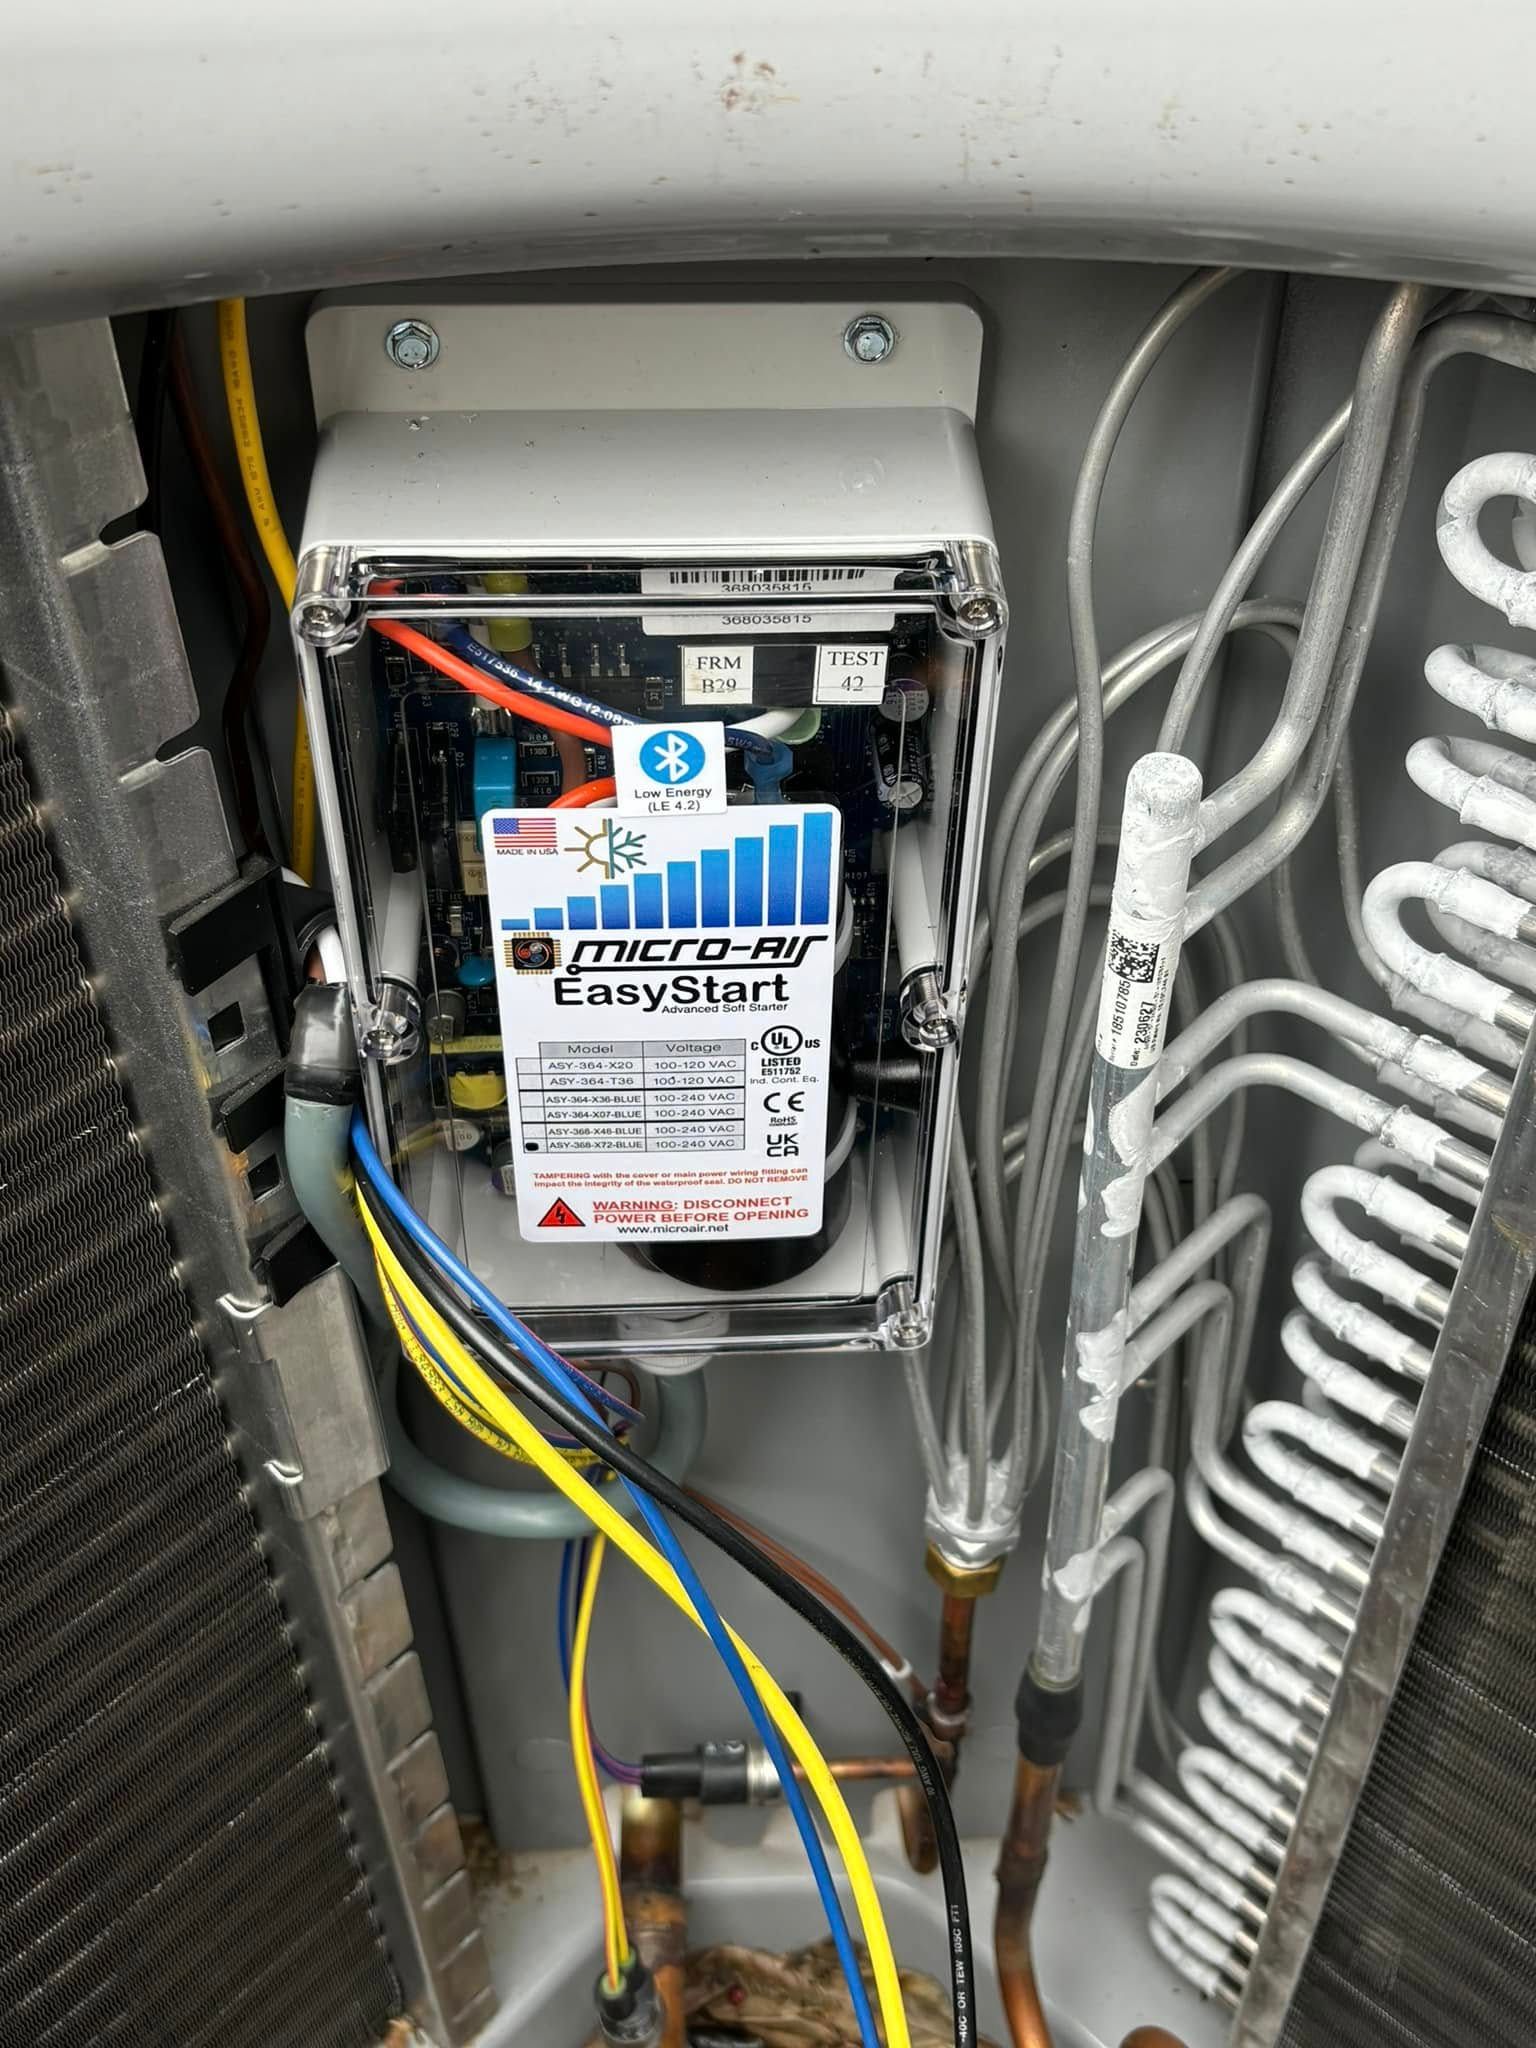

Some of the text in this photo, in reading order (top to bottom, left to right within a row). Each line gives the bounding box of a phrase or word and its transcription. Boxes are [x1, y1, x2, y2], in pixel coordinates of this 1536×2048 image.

[697, 656, 742, 670] FRM
[827, 651, 884, 666] TEST
[702, 678, 737, 694] B29
[841, 675, 864, 691] 42
[545, 687, 582, 708] AWG
[634, 786, 713, 800] Low Energy
[648, 800, 701, 814] (LE 4.2)
[496, 848, 559, 857] MADE IN USA
[554, 973, 790, 1013] EasyStart
[661, 1001, 788, 1015] Advanced Soft Starter
[1111, 980, 1132, 1037] 18510785
[1134, 1001, 1156, 1045] 230627
[567, 1043, 614, 1054] Model
[666, 1042, 722, 1055] Voltage
[548, 1060, 633, 1070] ASY-364-X20
[654, 1059, 737, 1070] 100-120 VAC
[761, 1056, 801, 1068] LISTED
[761, 1067, 801, 1076] E511752
[549, 1076, 634, 1086] ASY-364-T36
[653, 1075, 736, 1086] 100-120 VAC
[750, 1075, 819, 1085] Ind. Cont. Eq.
[653, 1092, 736, 1102] 100-240 VAC
[653, 1107, 736, 1118] 100-240 VAC
[654, 1124, 736, 1135] 100-240 VAC
[655, 1139, 736, 1149] 100-240 VAC
[767, 1134, 799, 1146] UK
[766, 1146, 799, 1157] CA
[533, 1172, 591, 1180] TAMPERING
[592, 1171, 613, 1179] with
[615, 1171, 631, 1179] the
[632, 1171, 659, 1179] cover
[674, 1170, 697, 1178] main
[699, 1171, 728, 1180] power
[730, 1169, 759, 1179] wiring
[761, 1168, 788, 1177] fitting
[568, 1180, 583, 1188] the
[584, 1179, 621, 1189] integrity
[624, 1179, 634, 1187] of
[635, 1179, 650, 1187] the
[651, 1178, 703, 1188] waterproof
[704, 1178, 726, 1186] seal.
[744, 1176, 765, 1184] NOT
[767, 1175, 808, 1183] REMOVE
[593, 1196, 793, 1212] WARNING: DISCONNECT
[594, 1208, 809, 1224] POWER BEFORE OPENING
[617, 1223, 729, 1234] www.microair.net
[953, 1928, 963, 1954] 105C
[955, 1960, 965, 1985] TEW
[957, 1991, 967, 2010] OR
